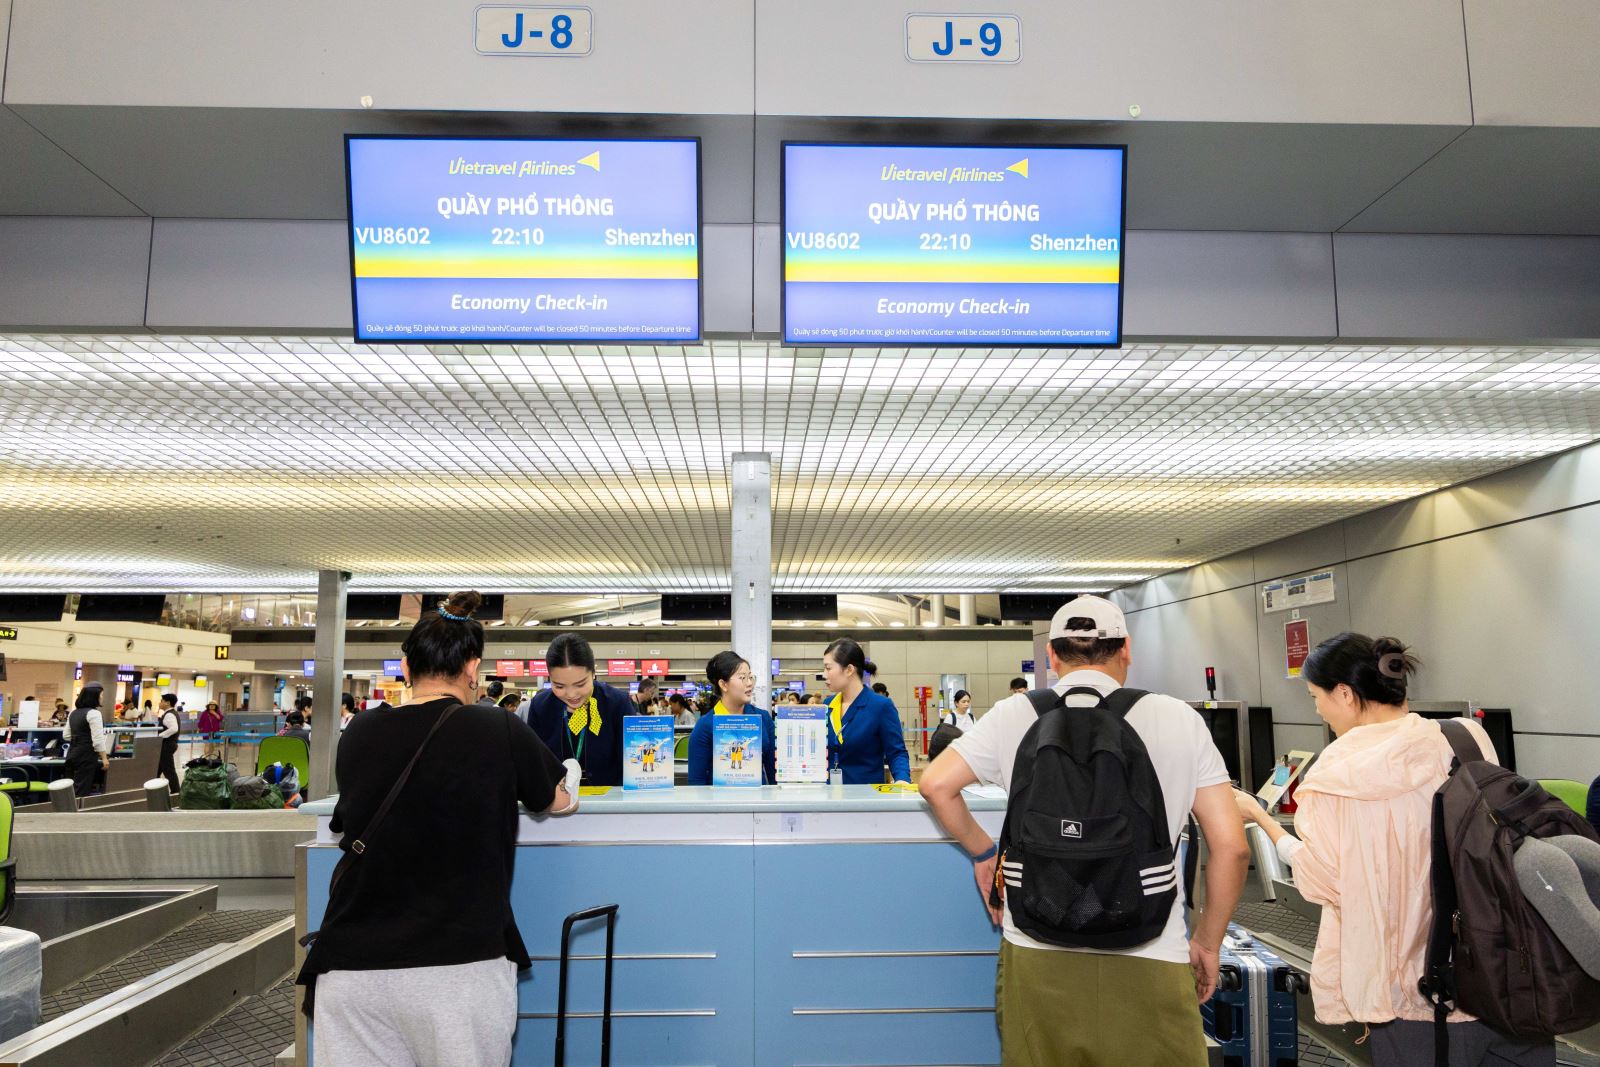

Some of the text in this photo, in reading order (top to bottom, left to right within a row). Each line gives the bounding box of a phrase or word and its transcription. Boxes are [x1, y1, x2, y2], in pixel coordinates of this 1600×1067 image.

[501, 13, 573, 49] J-8
[932, 22, 1002, 56] J-9
[448, 156, 576, 178] Vietravel Airlines
[881, 163, 1004, 184] Vietravel Airlines
[437, 192, 614, 218] QUẦY PHỔ THÔNG
[868, 198, 1040, 224] QUẦY PHỔ THÔNG
[355, 228, 695, 246] VU8602 22:10 Shenzhen
[788, 232, 1118, 251] VU8602 22:10 Shenzhen
[451, 295, 608, 314] Economy Check-in
[877, 299, 1030, 318] Economy Check-in
[642, 326, 675, 334] Departure
[1062, 329, 1094, 337] Departure
[217, 647, 228, 658] H
